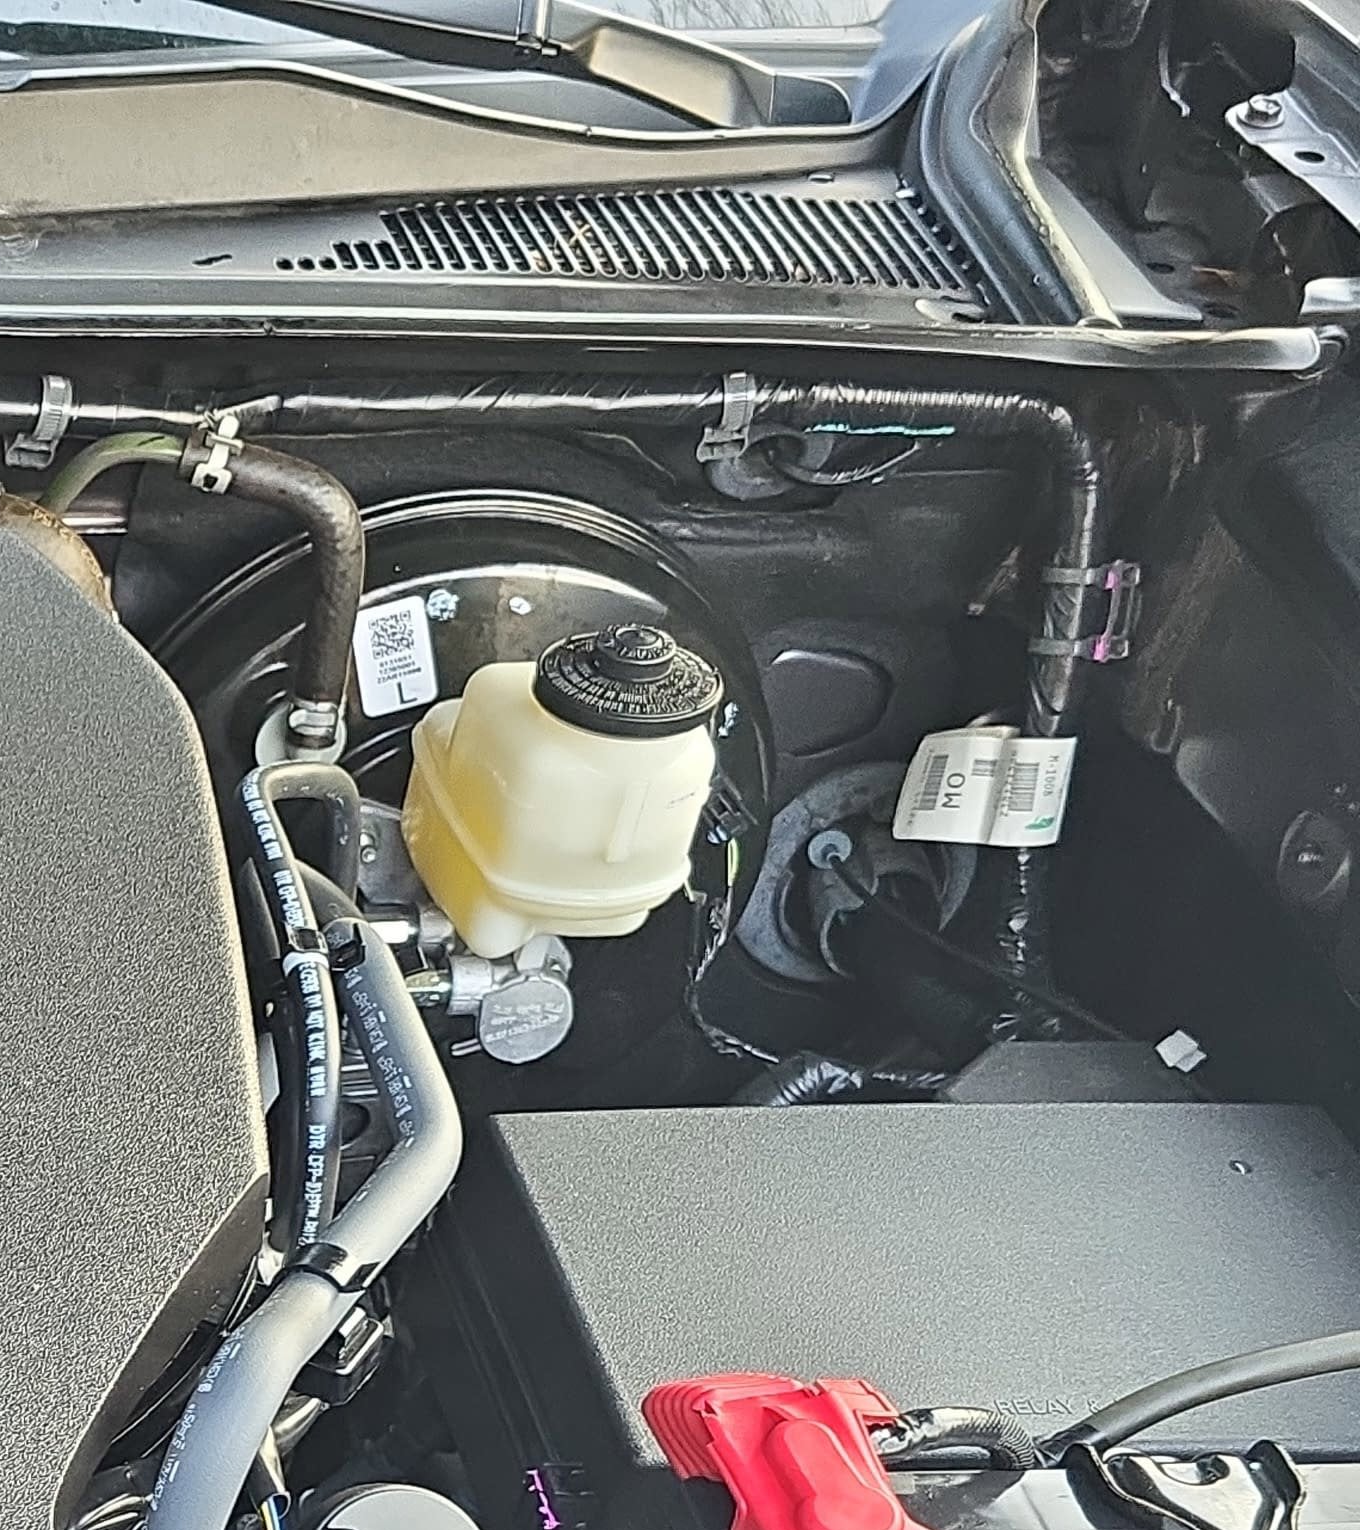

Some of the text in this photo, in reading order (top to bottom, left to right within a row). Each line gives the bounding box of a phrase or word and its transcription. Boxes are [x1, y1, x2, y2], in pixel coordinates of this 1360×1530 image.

[397, 681, 418, 704] L
[307, 1031, 326, 1062] KINK
[993, 1399, 1073, 1416] RELAY
